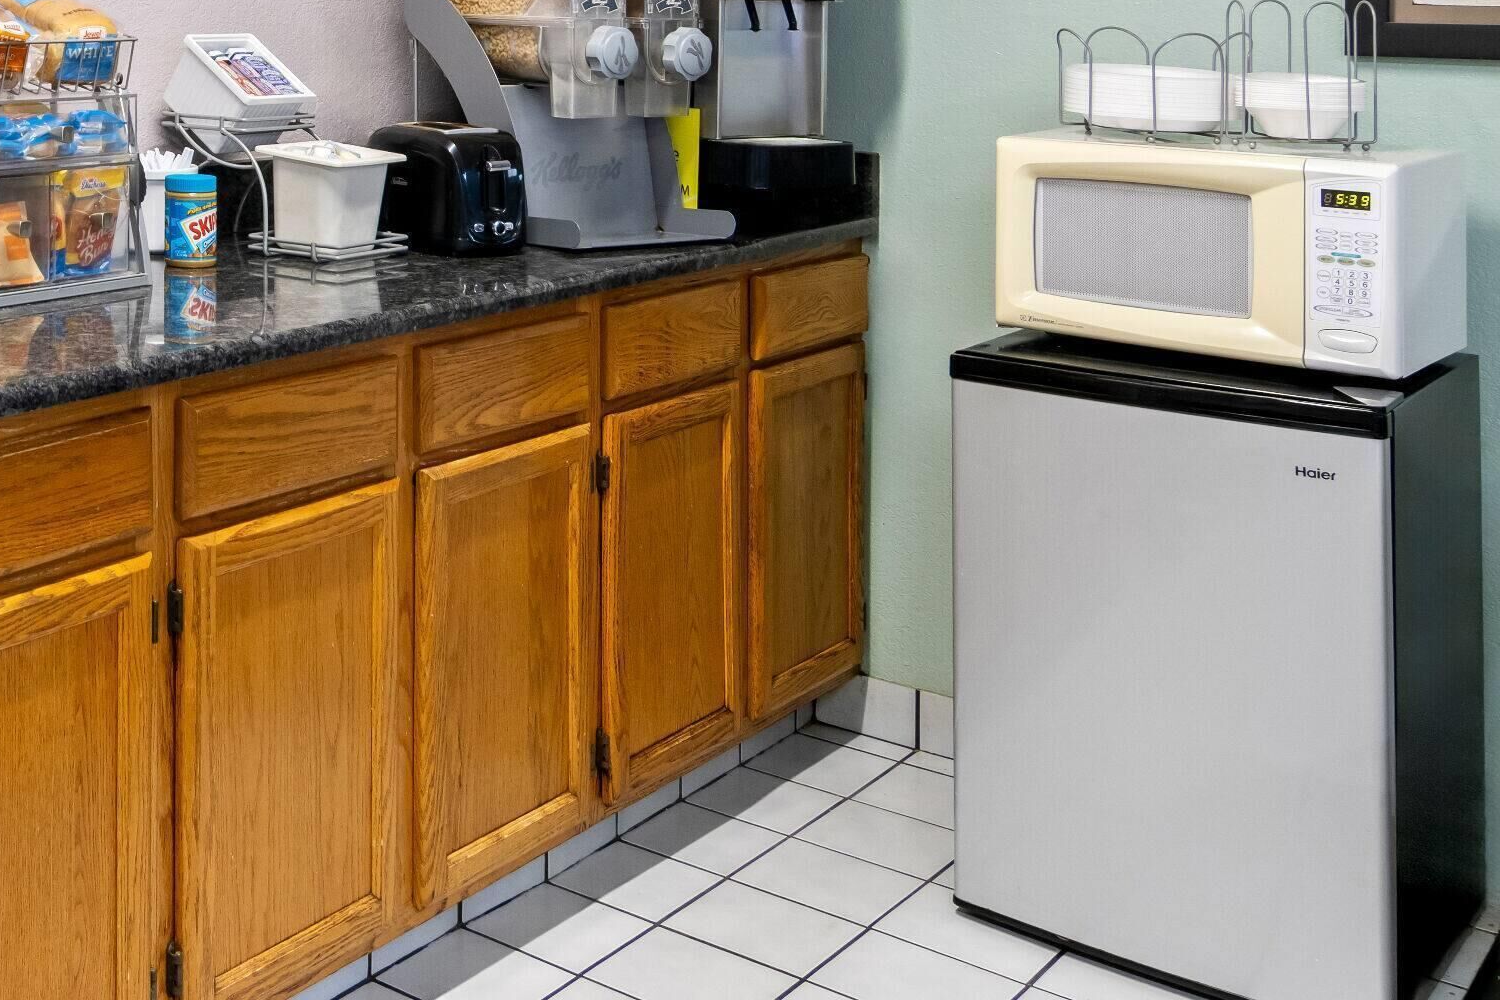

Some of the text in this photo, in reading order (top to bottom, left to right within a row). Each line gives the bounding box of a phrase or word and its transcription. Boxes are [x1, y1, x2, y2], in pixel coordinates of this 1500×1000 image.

[65, 44, 115, 60] WHITE
[530, 151, 623, 191] Kellogg's
[1335, 193, 1370, 207] 5:39
[1294, 465, 1336, 481] Haier
